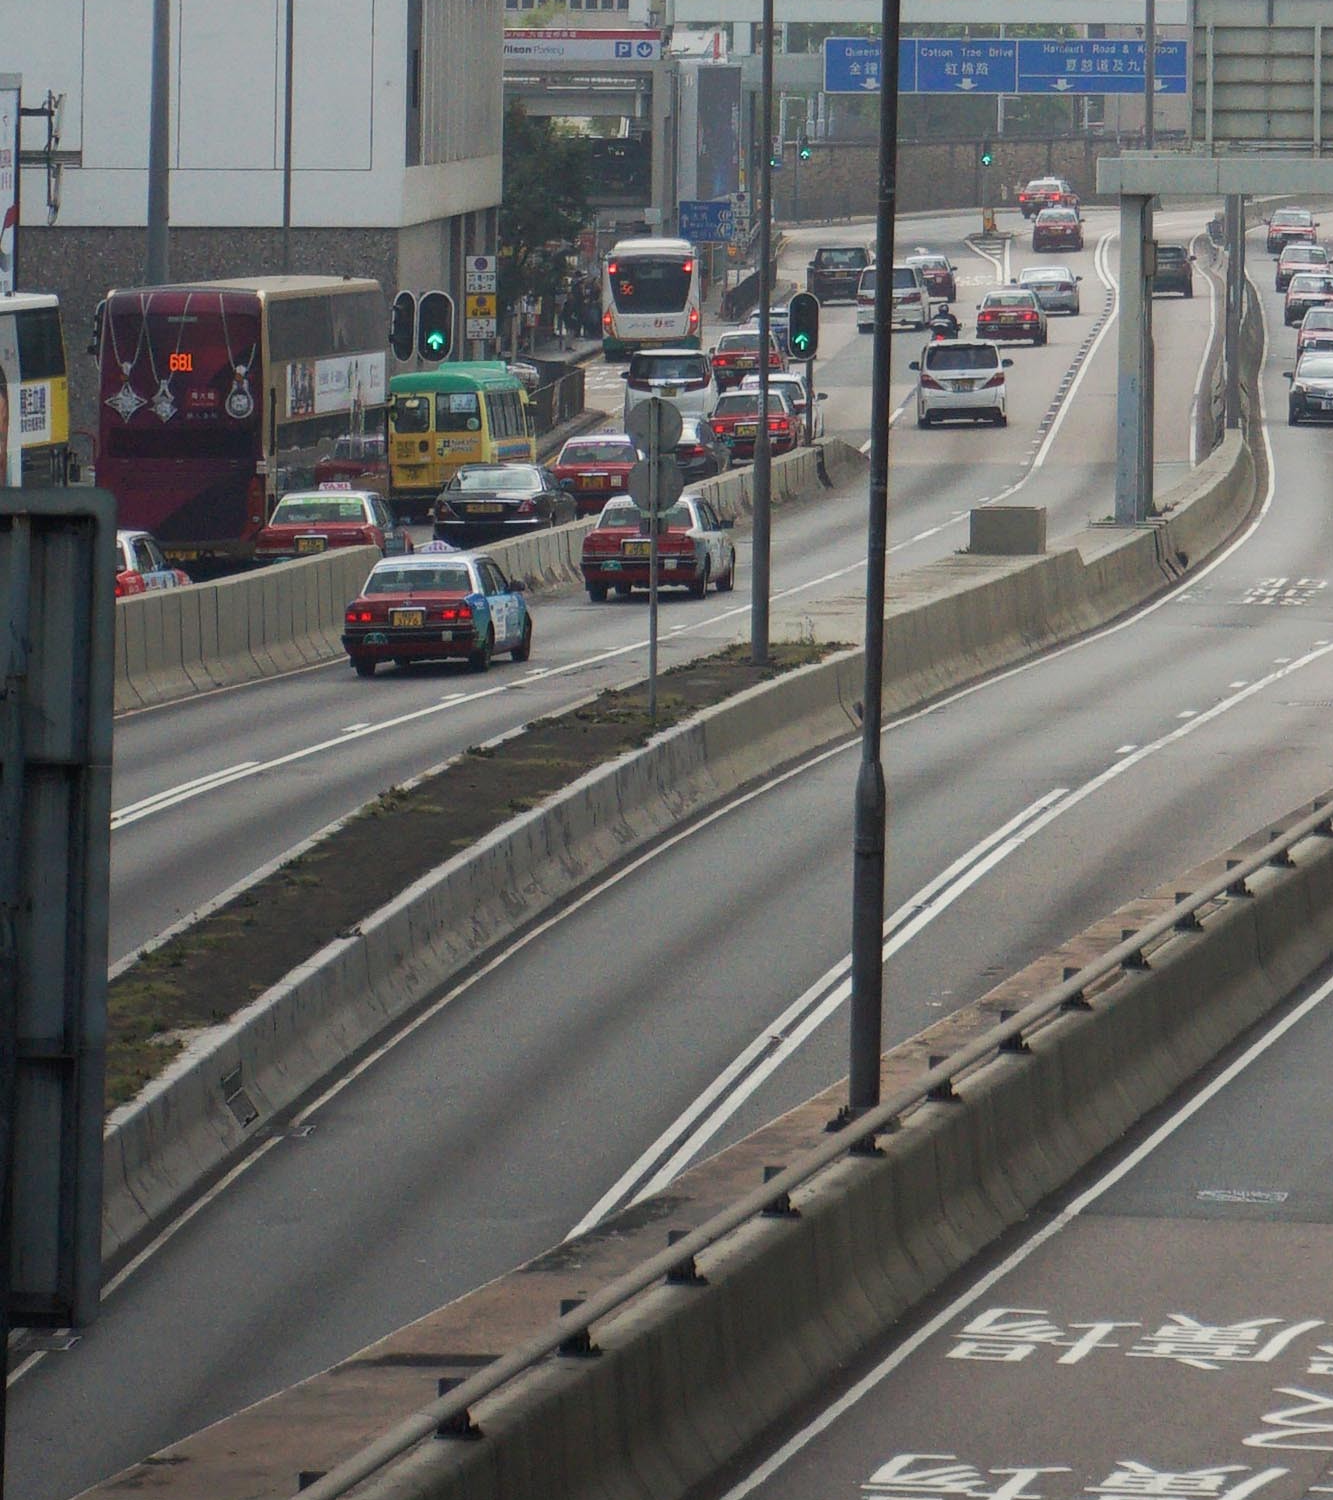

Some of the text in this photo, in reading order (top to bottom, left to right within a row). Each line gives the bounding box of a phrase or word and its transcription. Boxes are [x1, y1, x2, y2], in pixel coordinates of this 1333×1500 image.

[921, 47, 1014, 58] Cotton Tree Drive
[1042, 44, 1084, 54] Harcourt
[1092, 44, 1116, 54] Road
[1122, 44, 1130, 54] &
[944, 62, 989, 76] 紅棉路
[169, 353, 193, 372] 681
[322, 483, 349, 491] TAXI
